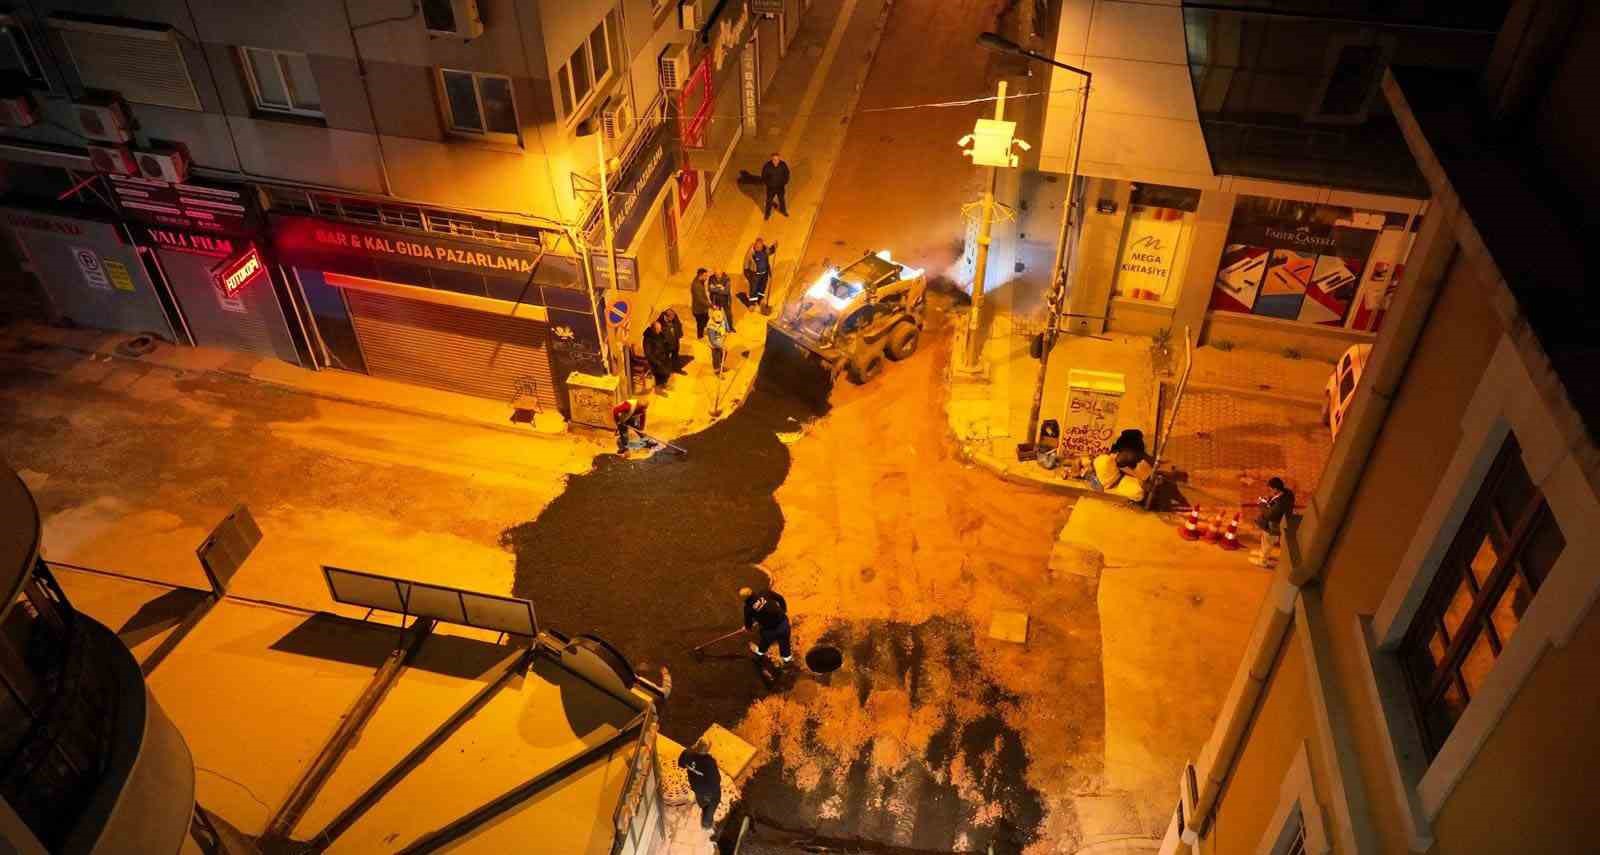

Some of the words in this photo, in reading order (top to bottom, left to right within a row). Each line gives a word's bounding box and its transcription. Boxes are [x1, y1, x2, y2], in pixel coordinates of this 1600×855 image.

[352, 237, 362, 248] &
[364, 236, 395, 254] KAL
[399, 241, 434, 260] GIDA
[435, 247, 532, 274] PAZARLAMA
[1131, 253, 1161, 263] MEGA
